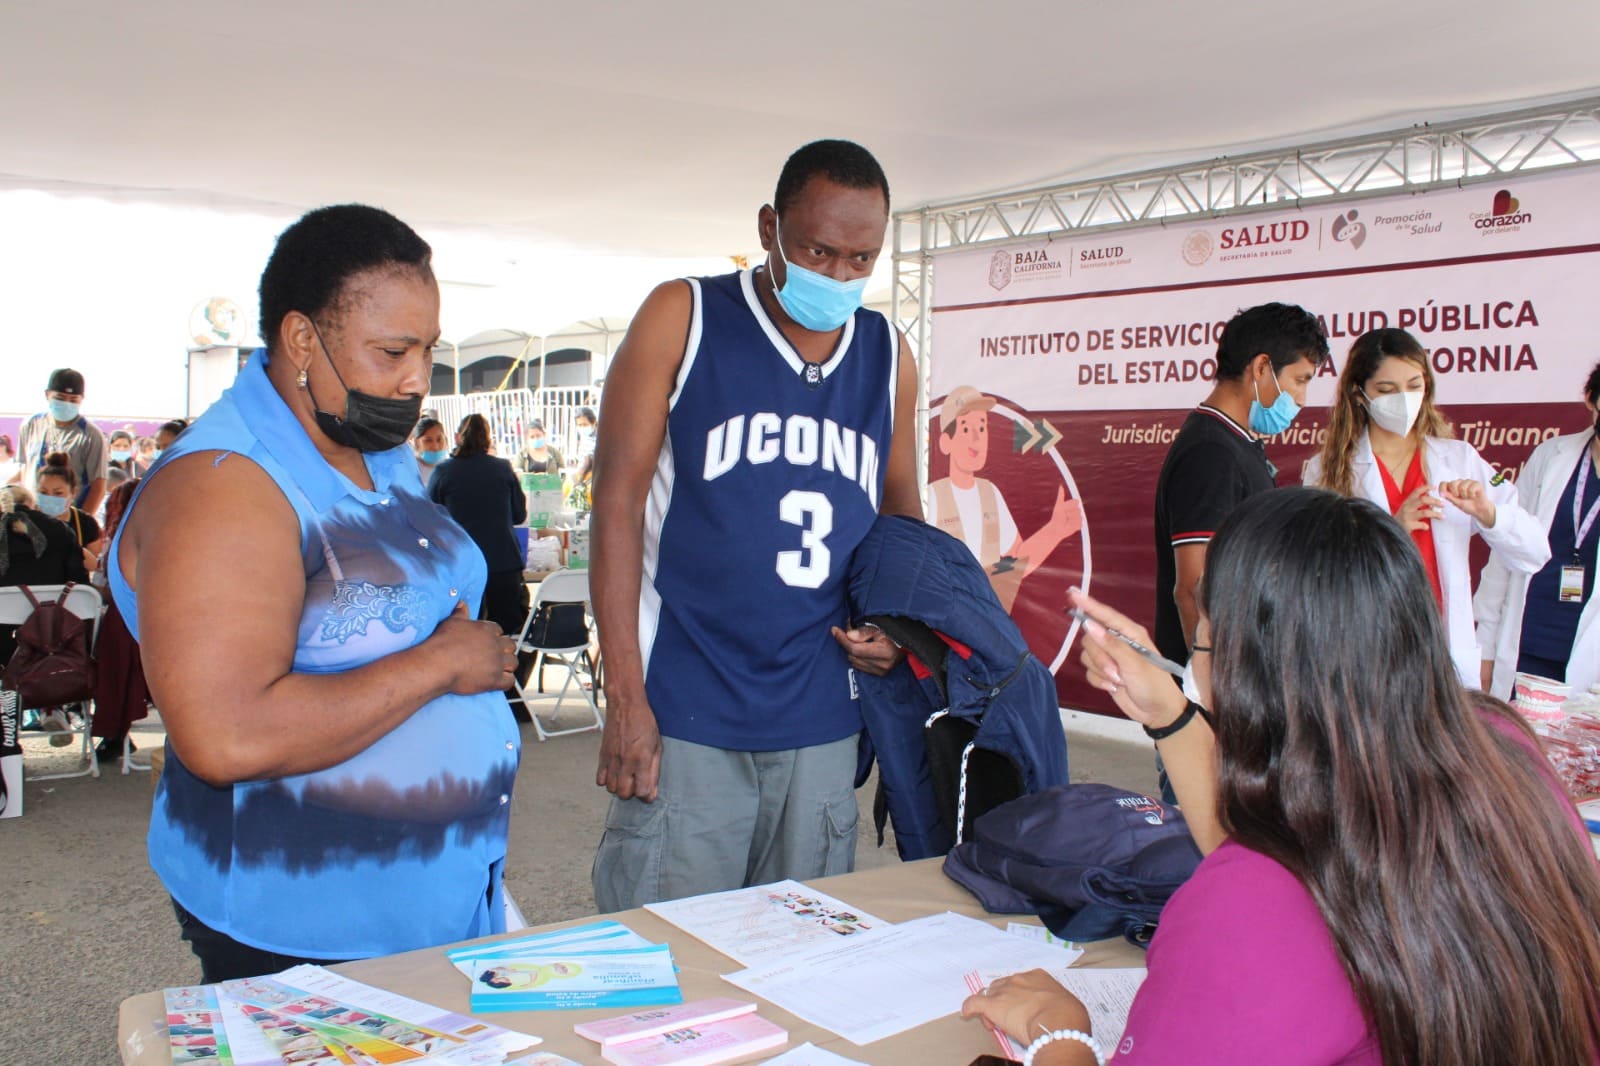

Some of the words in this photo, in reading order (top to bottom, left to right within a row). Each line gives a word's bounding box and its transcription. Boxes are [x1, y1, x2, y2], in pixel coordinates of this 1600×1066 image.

[1374, 209, 1432, 226] Promoción
[1410, 221, 1443, 235] Salud
[1474, 210, 1532, 229] corazón
[1219, 219, 1310, 250] SALUD
[1014, 249, 1048, 265] BAJA
[1080, 246, 1124, 262] SALUD
[1014, 261, 1062, 273] CALIFORNIA
[980, 331, 1080, 358] INSTITUTO
[1086, 329, 1114, 351] DE
[1121, 321, 1228, 350] SERVICIO
[1314, 310, 1389, 339] ALUD
[1399, 299, 1540, 334] PÚBLICA
[1078, 363, 1118, 385] DEL
[1125, 358, 1218, 384] ESTADO
[1101, 422, 1181, 444] Jurisdicc
[1460, 420, 1561, 452] Tijuana
[702, 412, 879, 515] UCONN
[775, 489, 834, 589] 3
